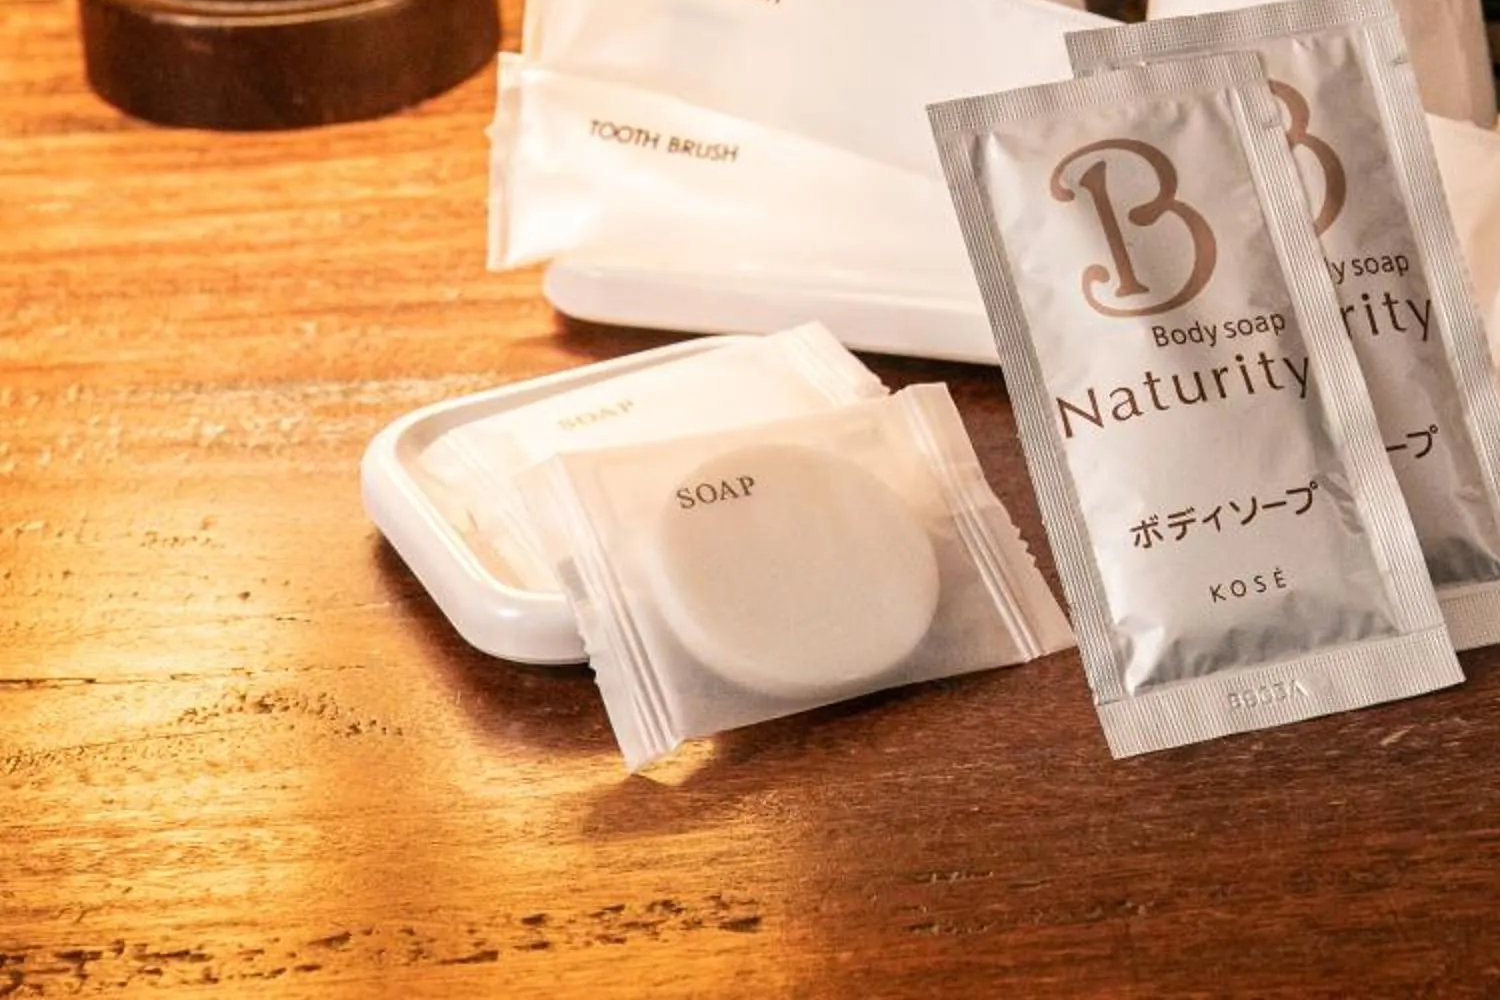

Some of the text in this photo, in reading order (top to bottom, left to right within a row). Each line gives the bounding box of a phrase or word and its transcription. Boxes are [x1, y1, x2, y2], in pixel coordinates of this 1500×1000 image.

[589, 119, 739, 163] TOOTH BRUSH
[1050, 137, 1217, 318] B
[1152, 311, 1286, 349] Body soap
[1056, 350, 1312, 439] Naturity
[676, 475, 756, 510] SOAP
[1130, 480, 1320, 551] ボディソープ
[1209, 567, 1289, 603] KOSÉ
